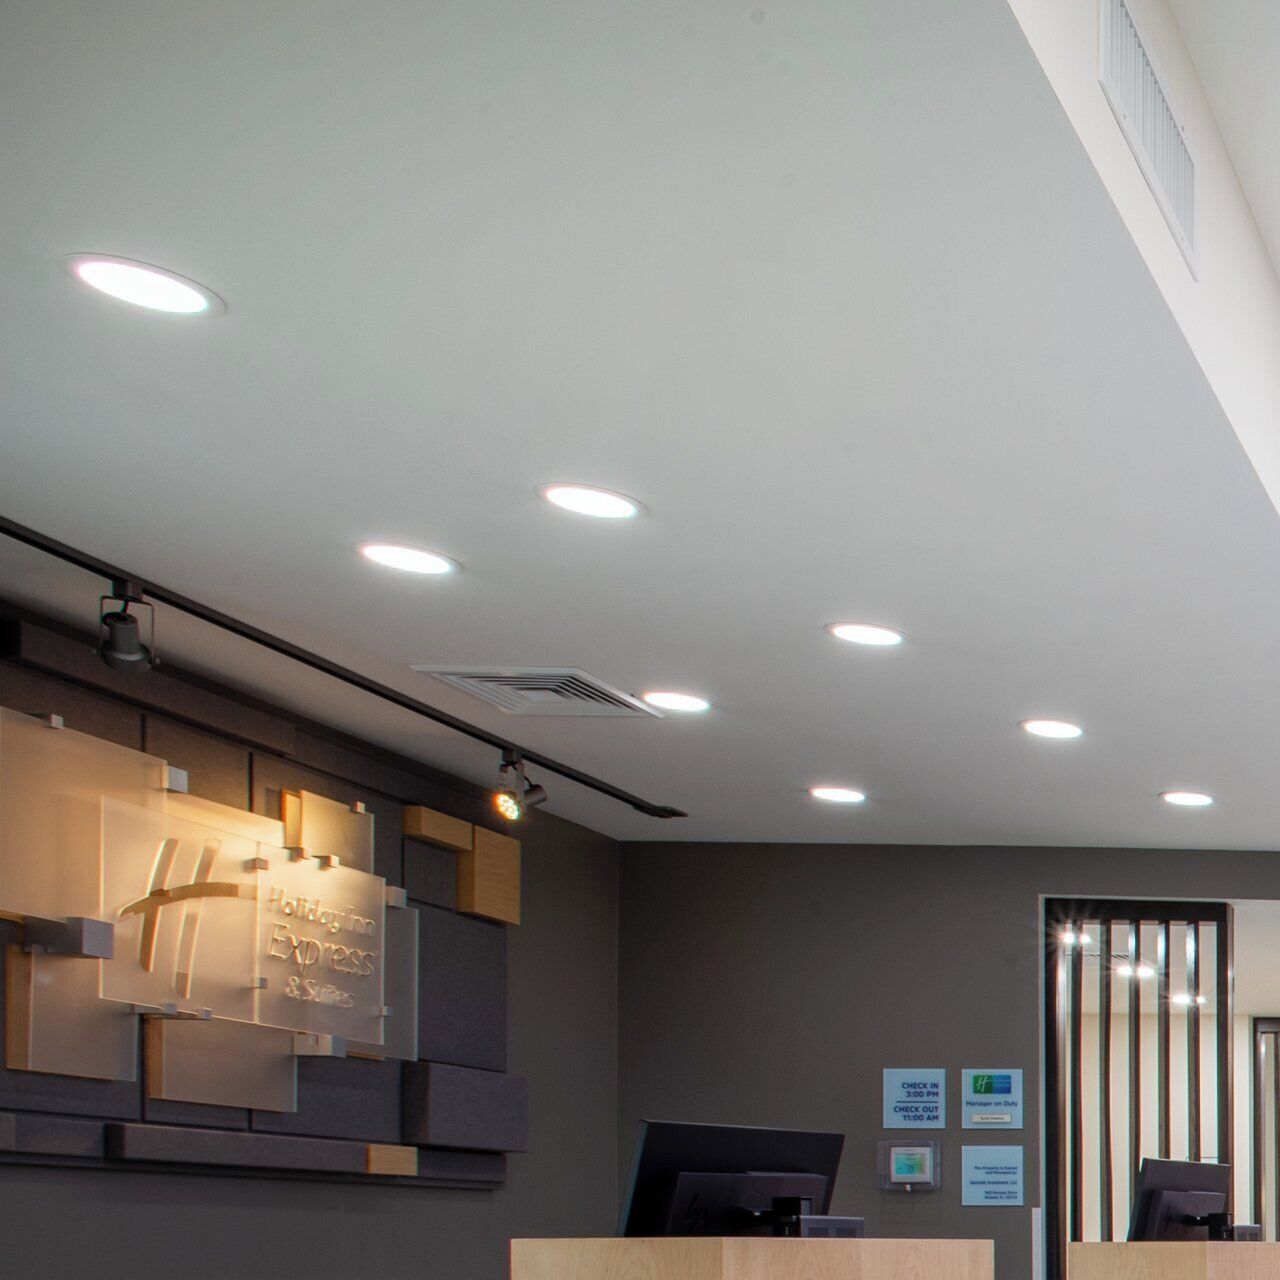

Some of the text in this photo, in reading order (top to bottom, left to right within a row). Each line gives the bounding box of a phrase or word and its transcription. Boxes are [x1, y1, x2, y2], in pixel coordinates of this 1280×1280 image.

[271, 886, 345, 932] Holiday
[269, 921, 375, 976] Express
[287, 976, 354, 1008] & Suites
[893, 1105, 939, 1113] CHECK OUT
[906, 1090, 939, 1098] 3:00 PM
